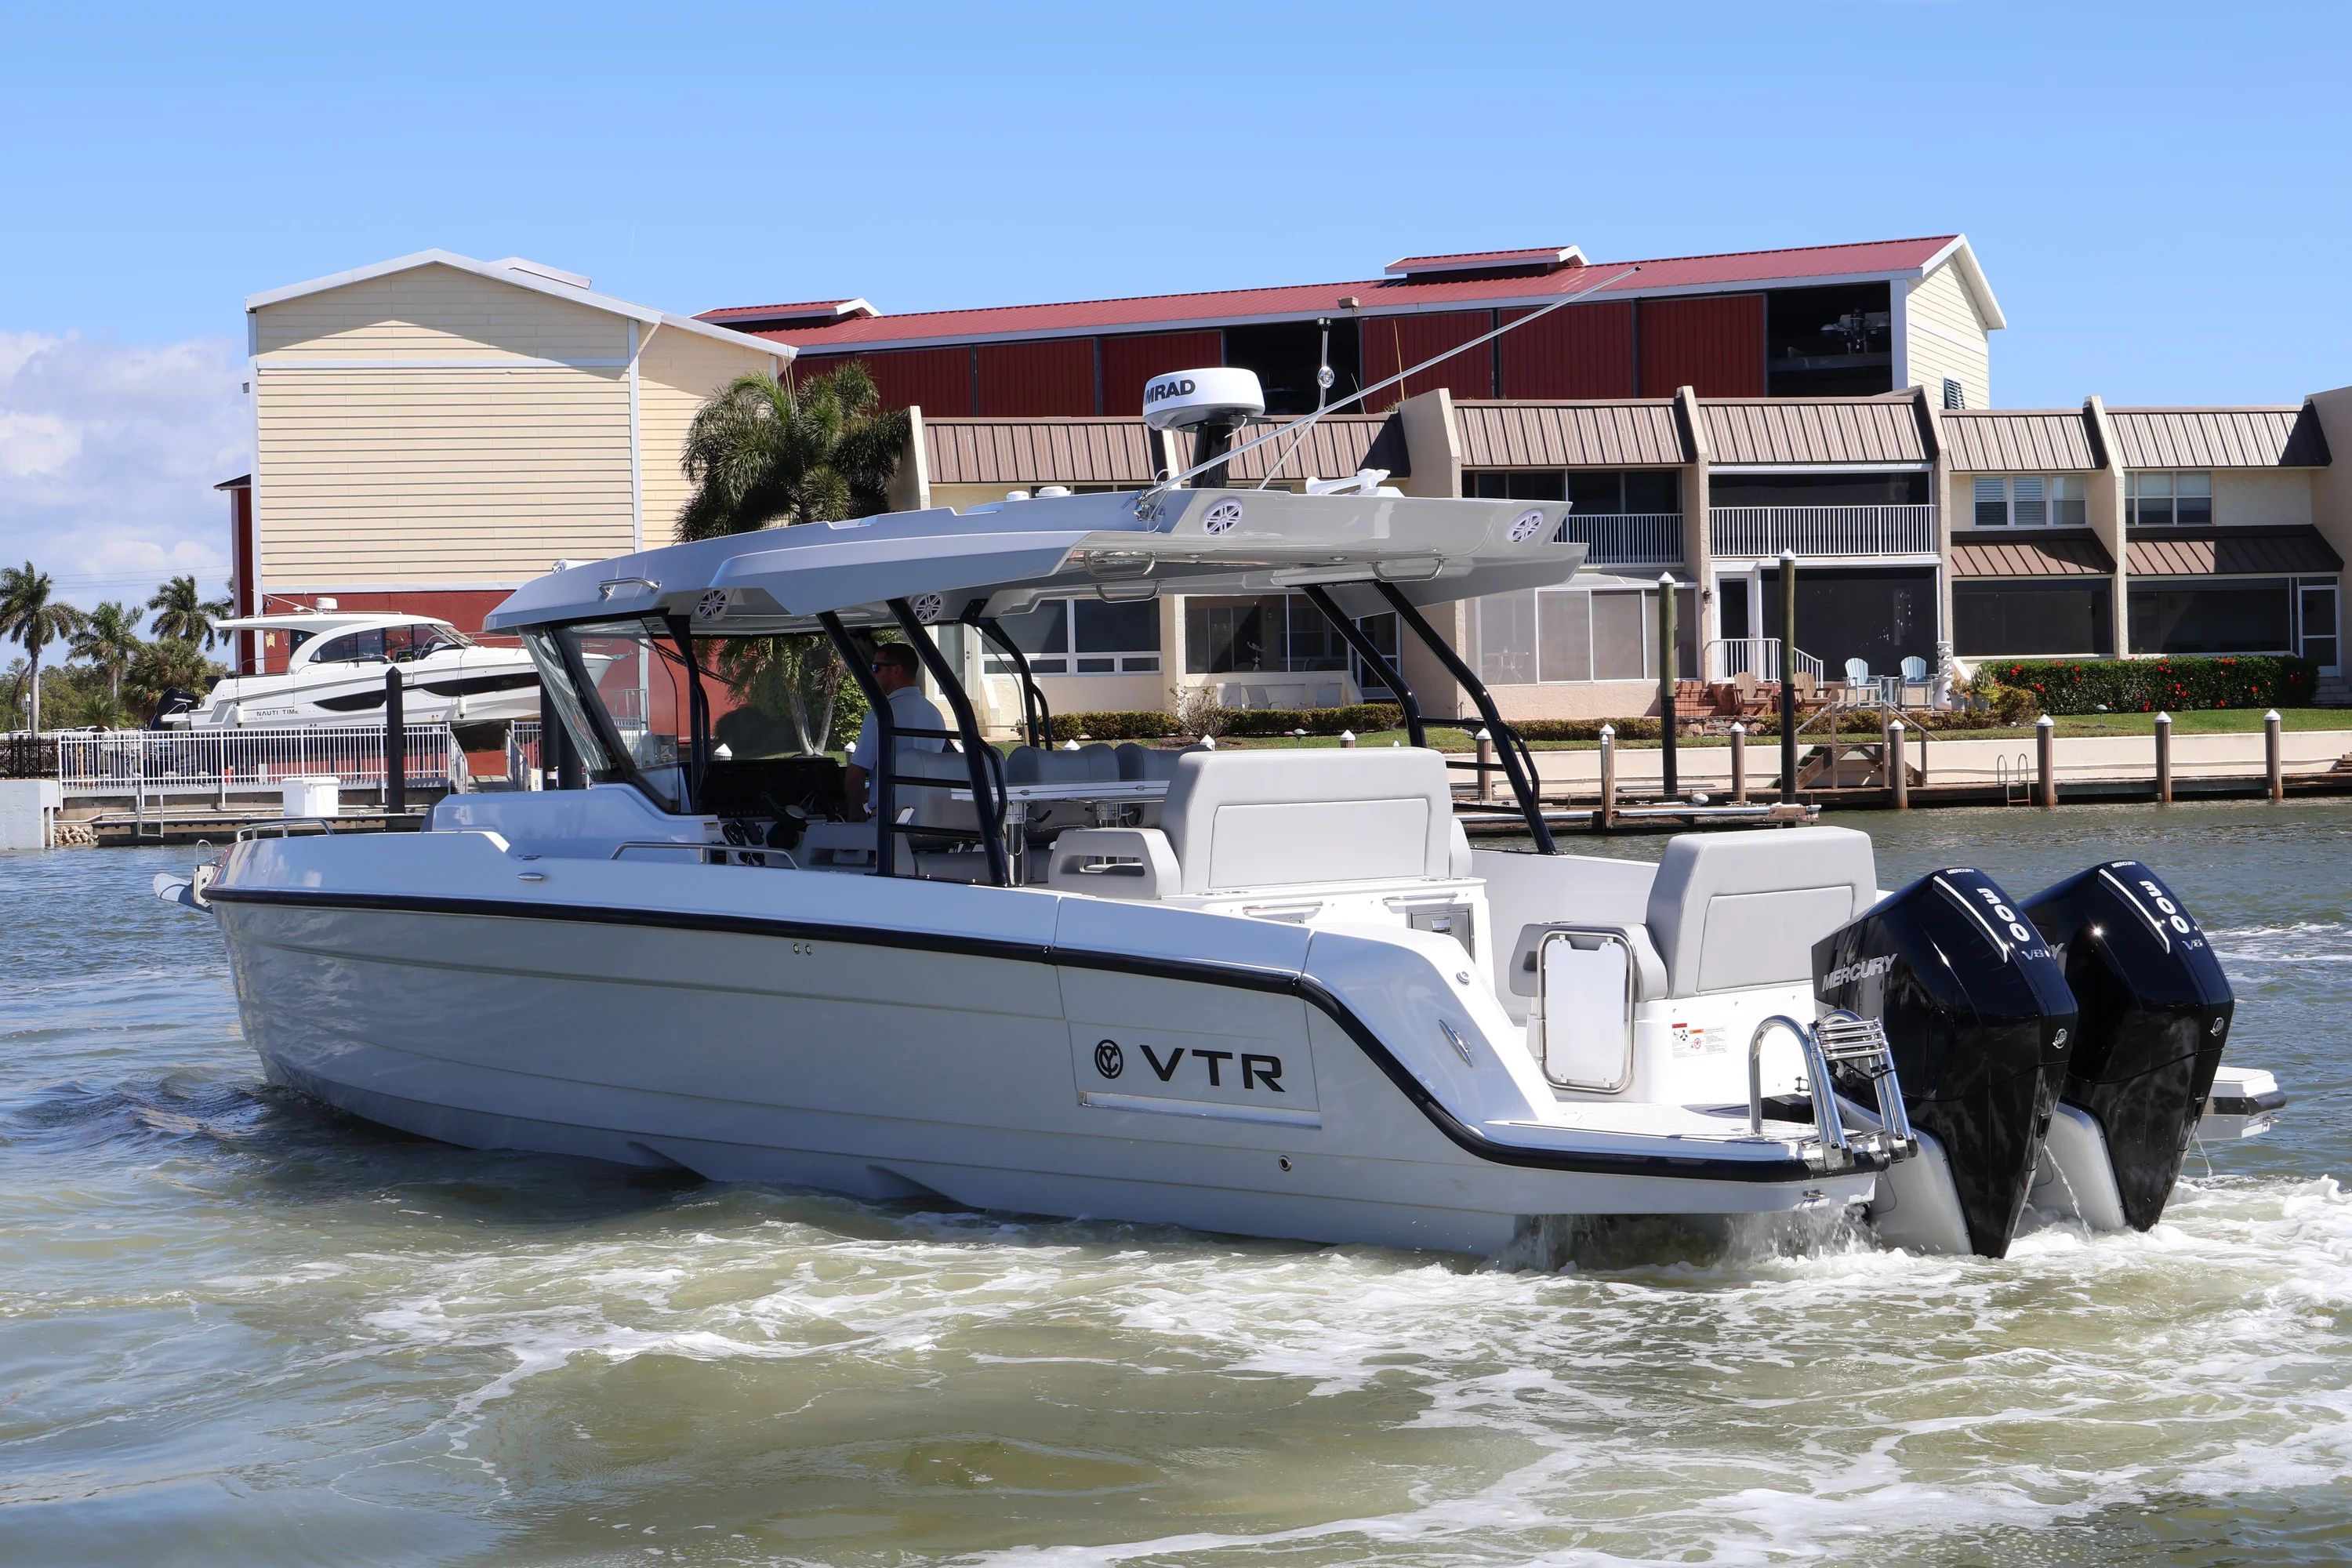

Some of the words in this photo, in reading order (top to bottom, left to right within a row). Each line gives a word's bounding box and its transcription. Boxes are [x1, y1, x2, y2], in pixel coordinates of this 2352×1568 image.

[1144, 379, 1196, 405] MRAD
[1976, 887, 2031, 942] 300
[2139, 880, 2190, 934] 300
[1821, 953, 1898, 993] MERCURY
[2021, 949, 2045, 960] V8
[1139, 1044, 1286, 1093] VTR
